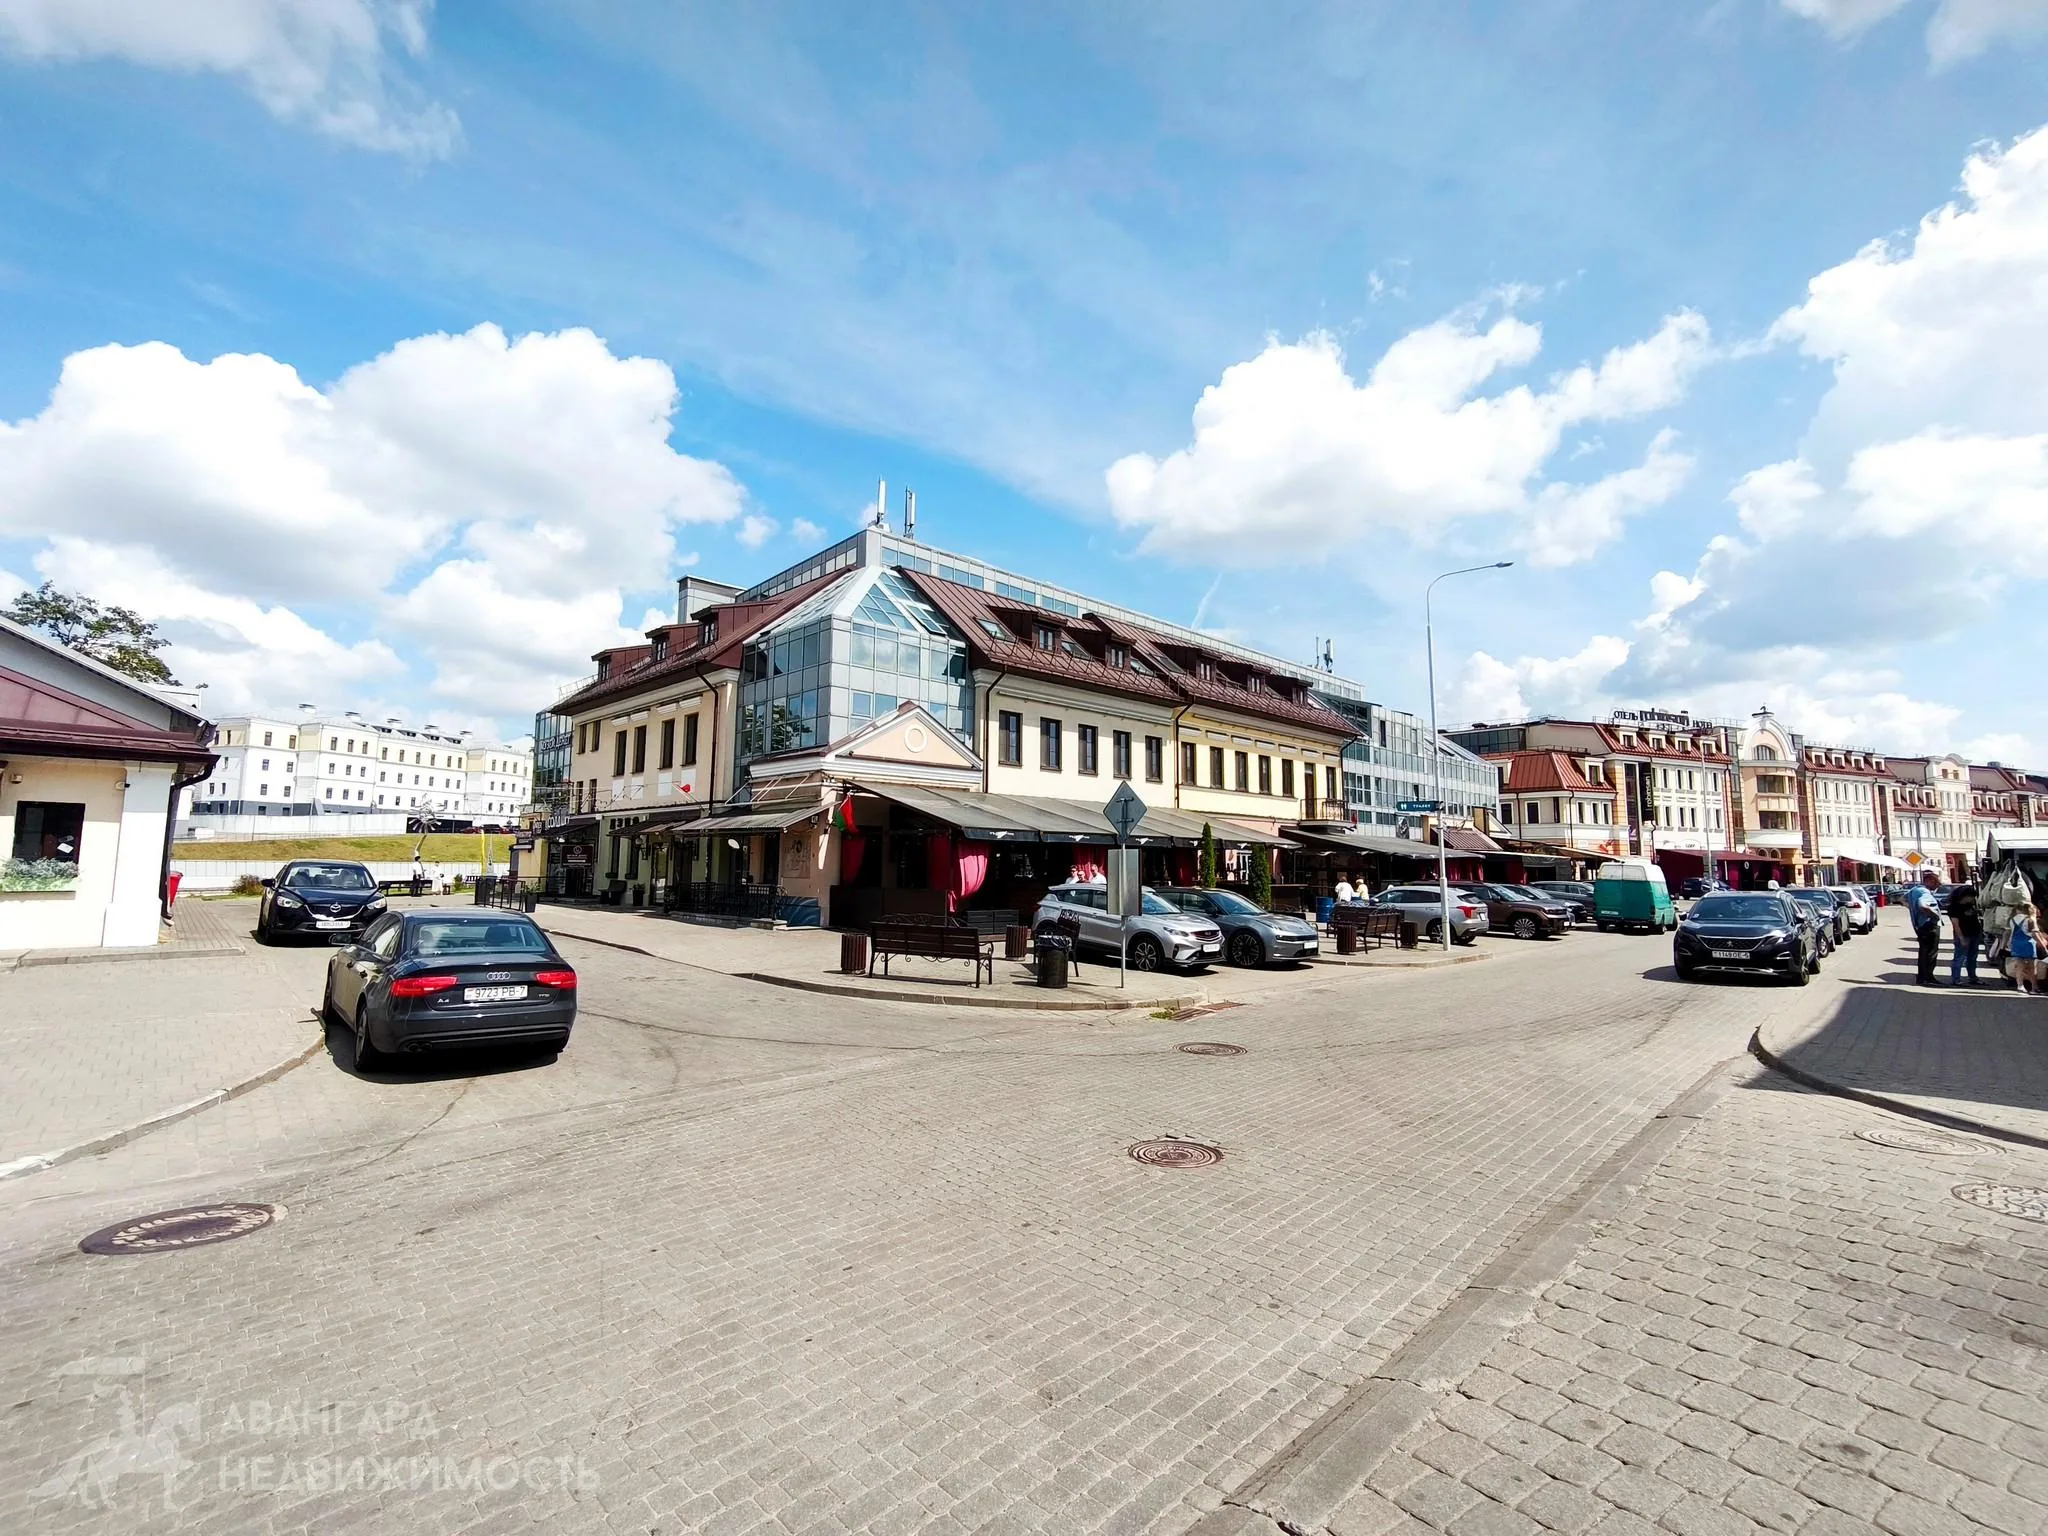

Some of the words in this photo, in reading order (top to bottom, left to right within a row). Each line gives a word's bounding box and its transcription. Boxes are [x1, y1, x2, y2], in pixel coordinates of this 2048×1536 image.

[1614, 710, 1639, 721] ОТЕЛЬ
[475, 987, 498, 998] 9723
[501, 986, 525, 997] PB-7
